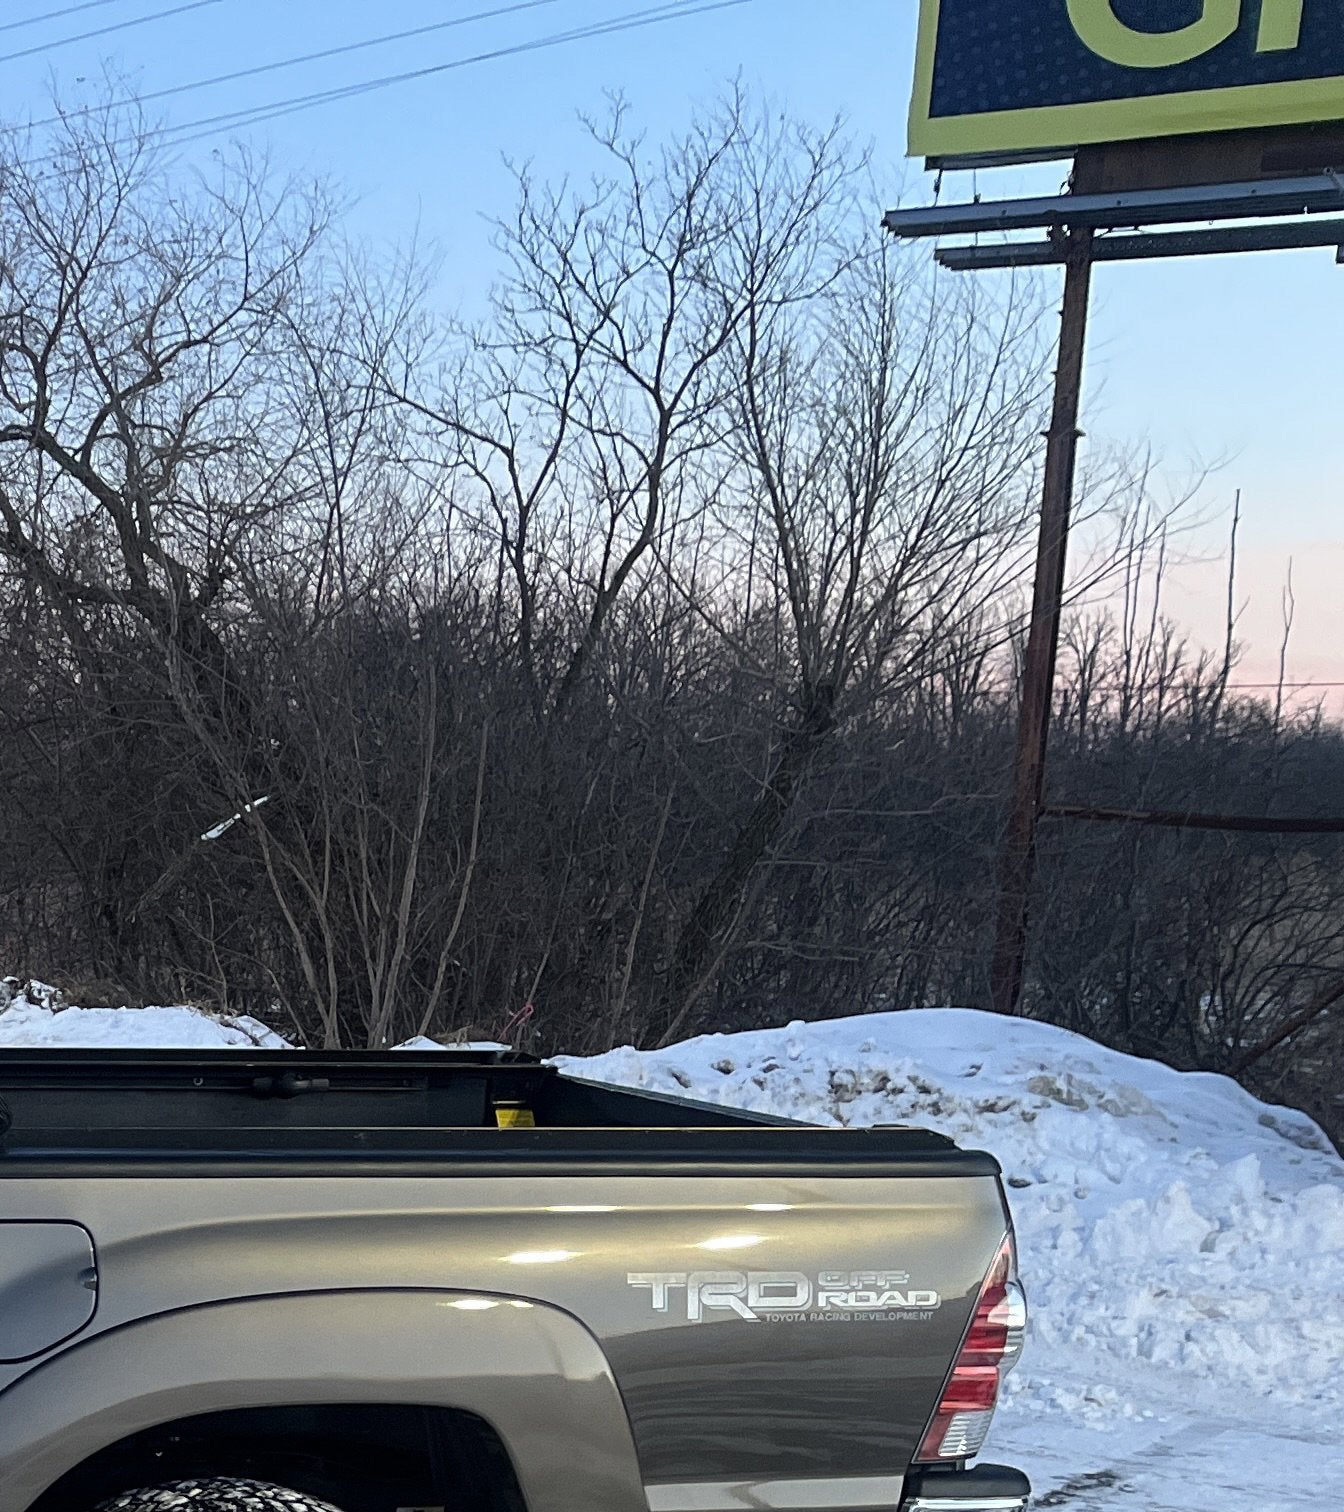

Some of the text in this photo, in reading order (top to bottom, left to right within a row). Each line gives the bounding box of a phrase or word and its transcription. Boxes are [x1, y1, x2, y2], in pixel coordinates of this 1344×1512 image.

[818, 1270, 909, 1289] OFF
[627, 1271, 812, 1323] TRD
[818, 1291, 941, 1310] ROAD
[765, 1311, 934, 1322] TOYOTA RACING DEVELOPMENT
